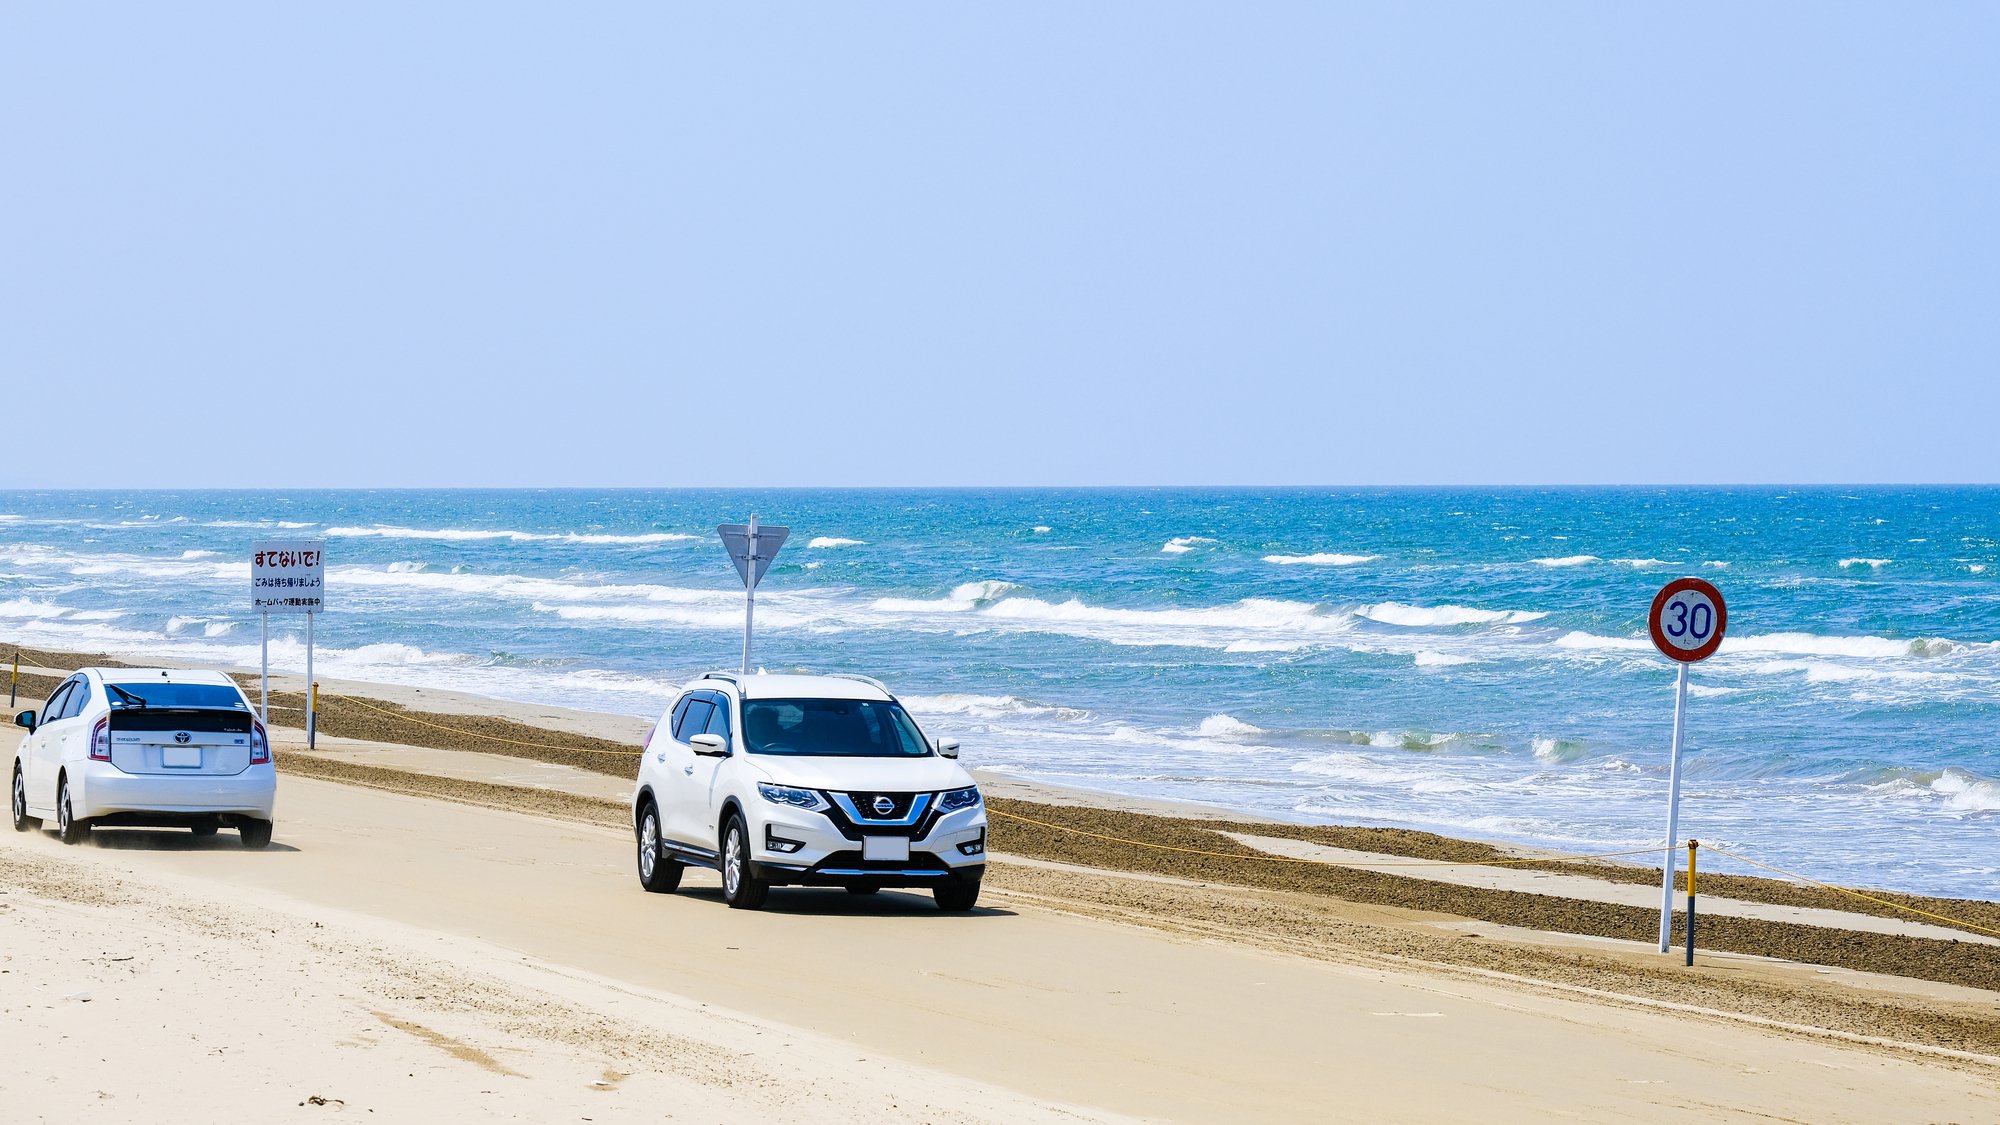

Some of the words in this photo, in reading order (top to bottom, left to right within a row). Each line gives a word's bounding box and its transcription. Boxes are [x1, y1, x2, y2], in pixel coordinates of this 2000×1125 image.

[255, 551, 320, 567] すてないで!
[255, 577, 321, 587] ごみは持ち帰りましょう
[1667, 601, 1711, 639] 30
